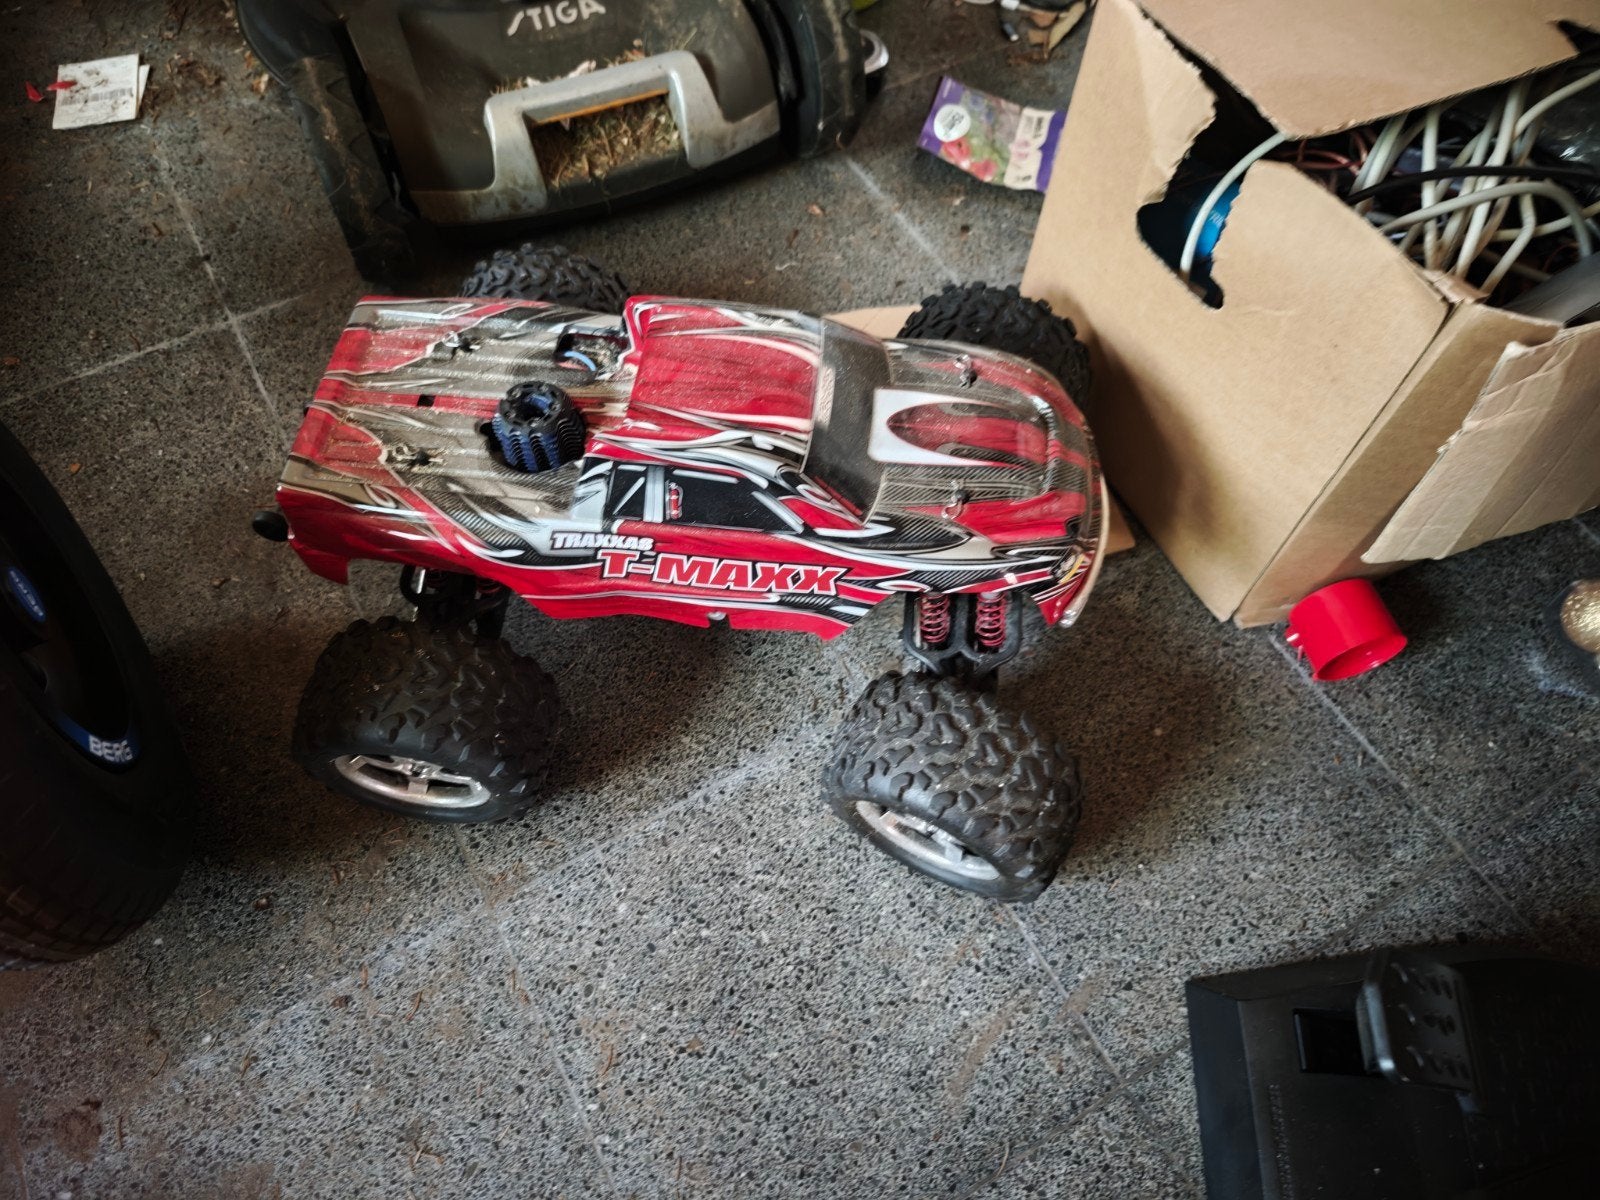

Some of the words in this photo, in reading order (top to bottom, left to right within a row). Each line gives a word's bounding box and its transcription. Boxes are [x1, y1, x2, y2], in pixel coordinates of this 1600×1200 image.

[507, 0, 606, 36] STIGA
[551, 532, 653, 551] TRAXXAS
[597, 549, 850, 595] T-MAXX
[88, 734, 133, 762] BERG
